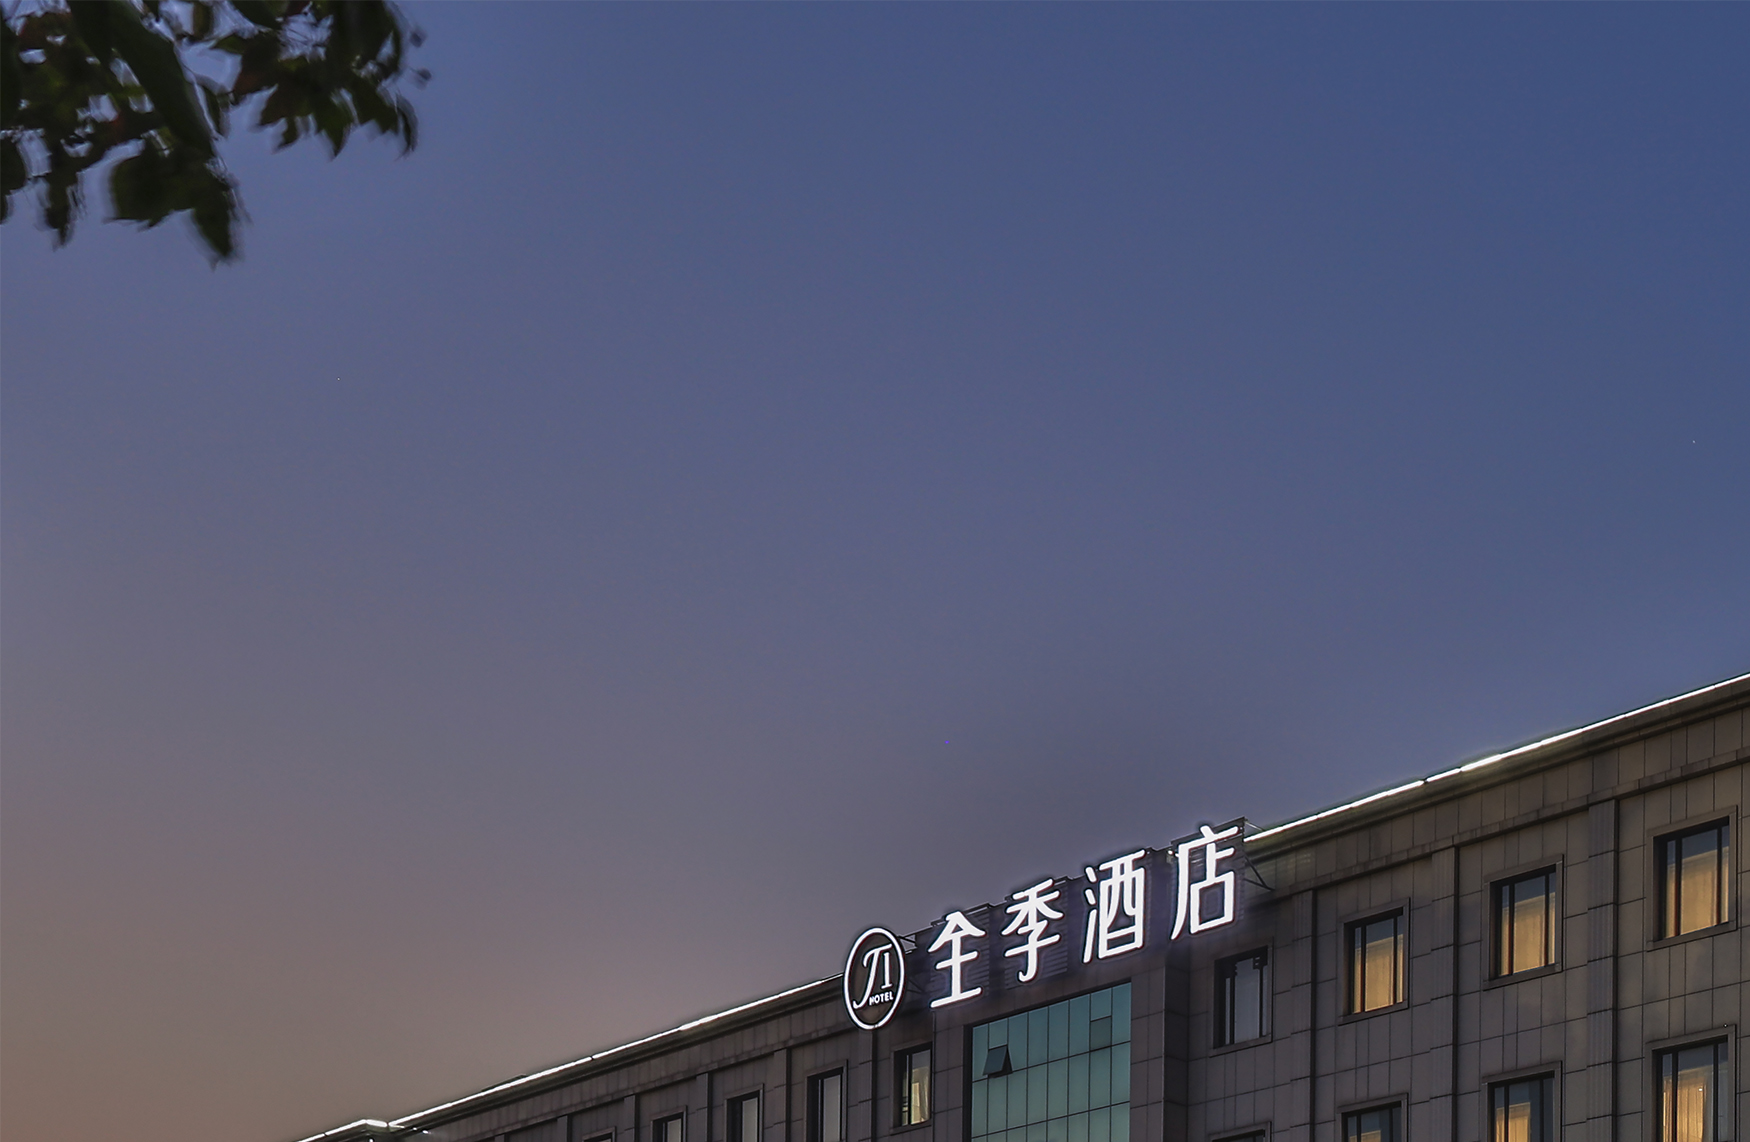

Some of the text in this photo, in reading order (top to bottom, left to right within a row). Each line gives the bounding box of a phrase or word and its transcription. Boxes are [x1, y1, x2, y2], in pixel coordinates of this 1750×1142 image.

[928, 825, 1240, 1009] 全季酒店
[868, 991, 894, 1006] HOTEL
